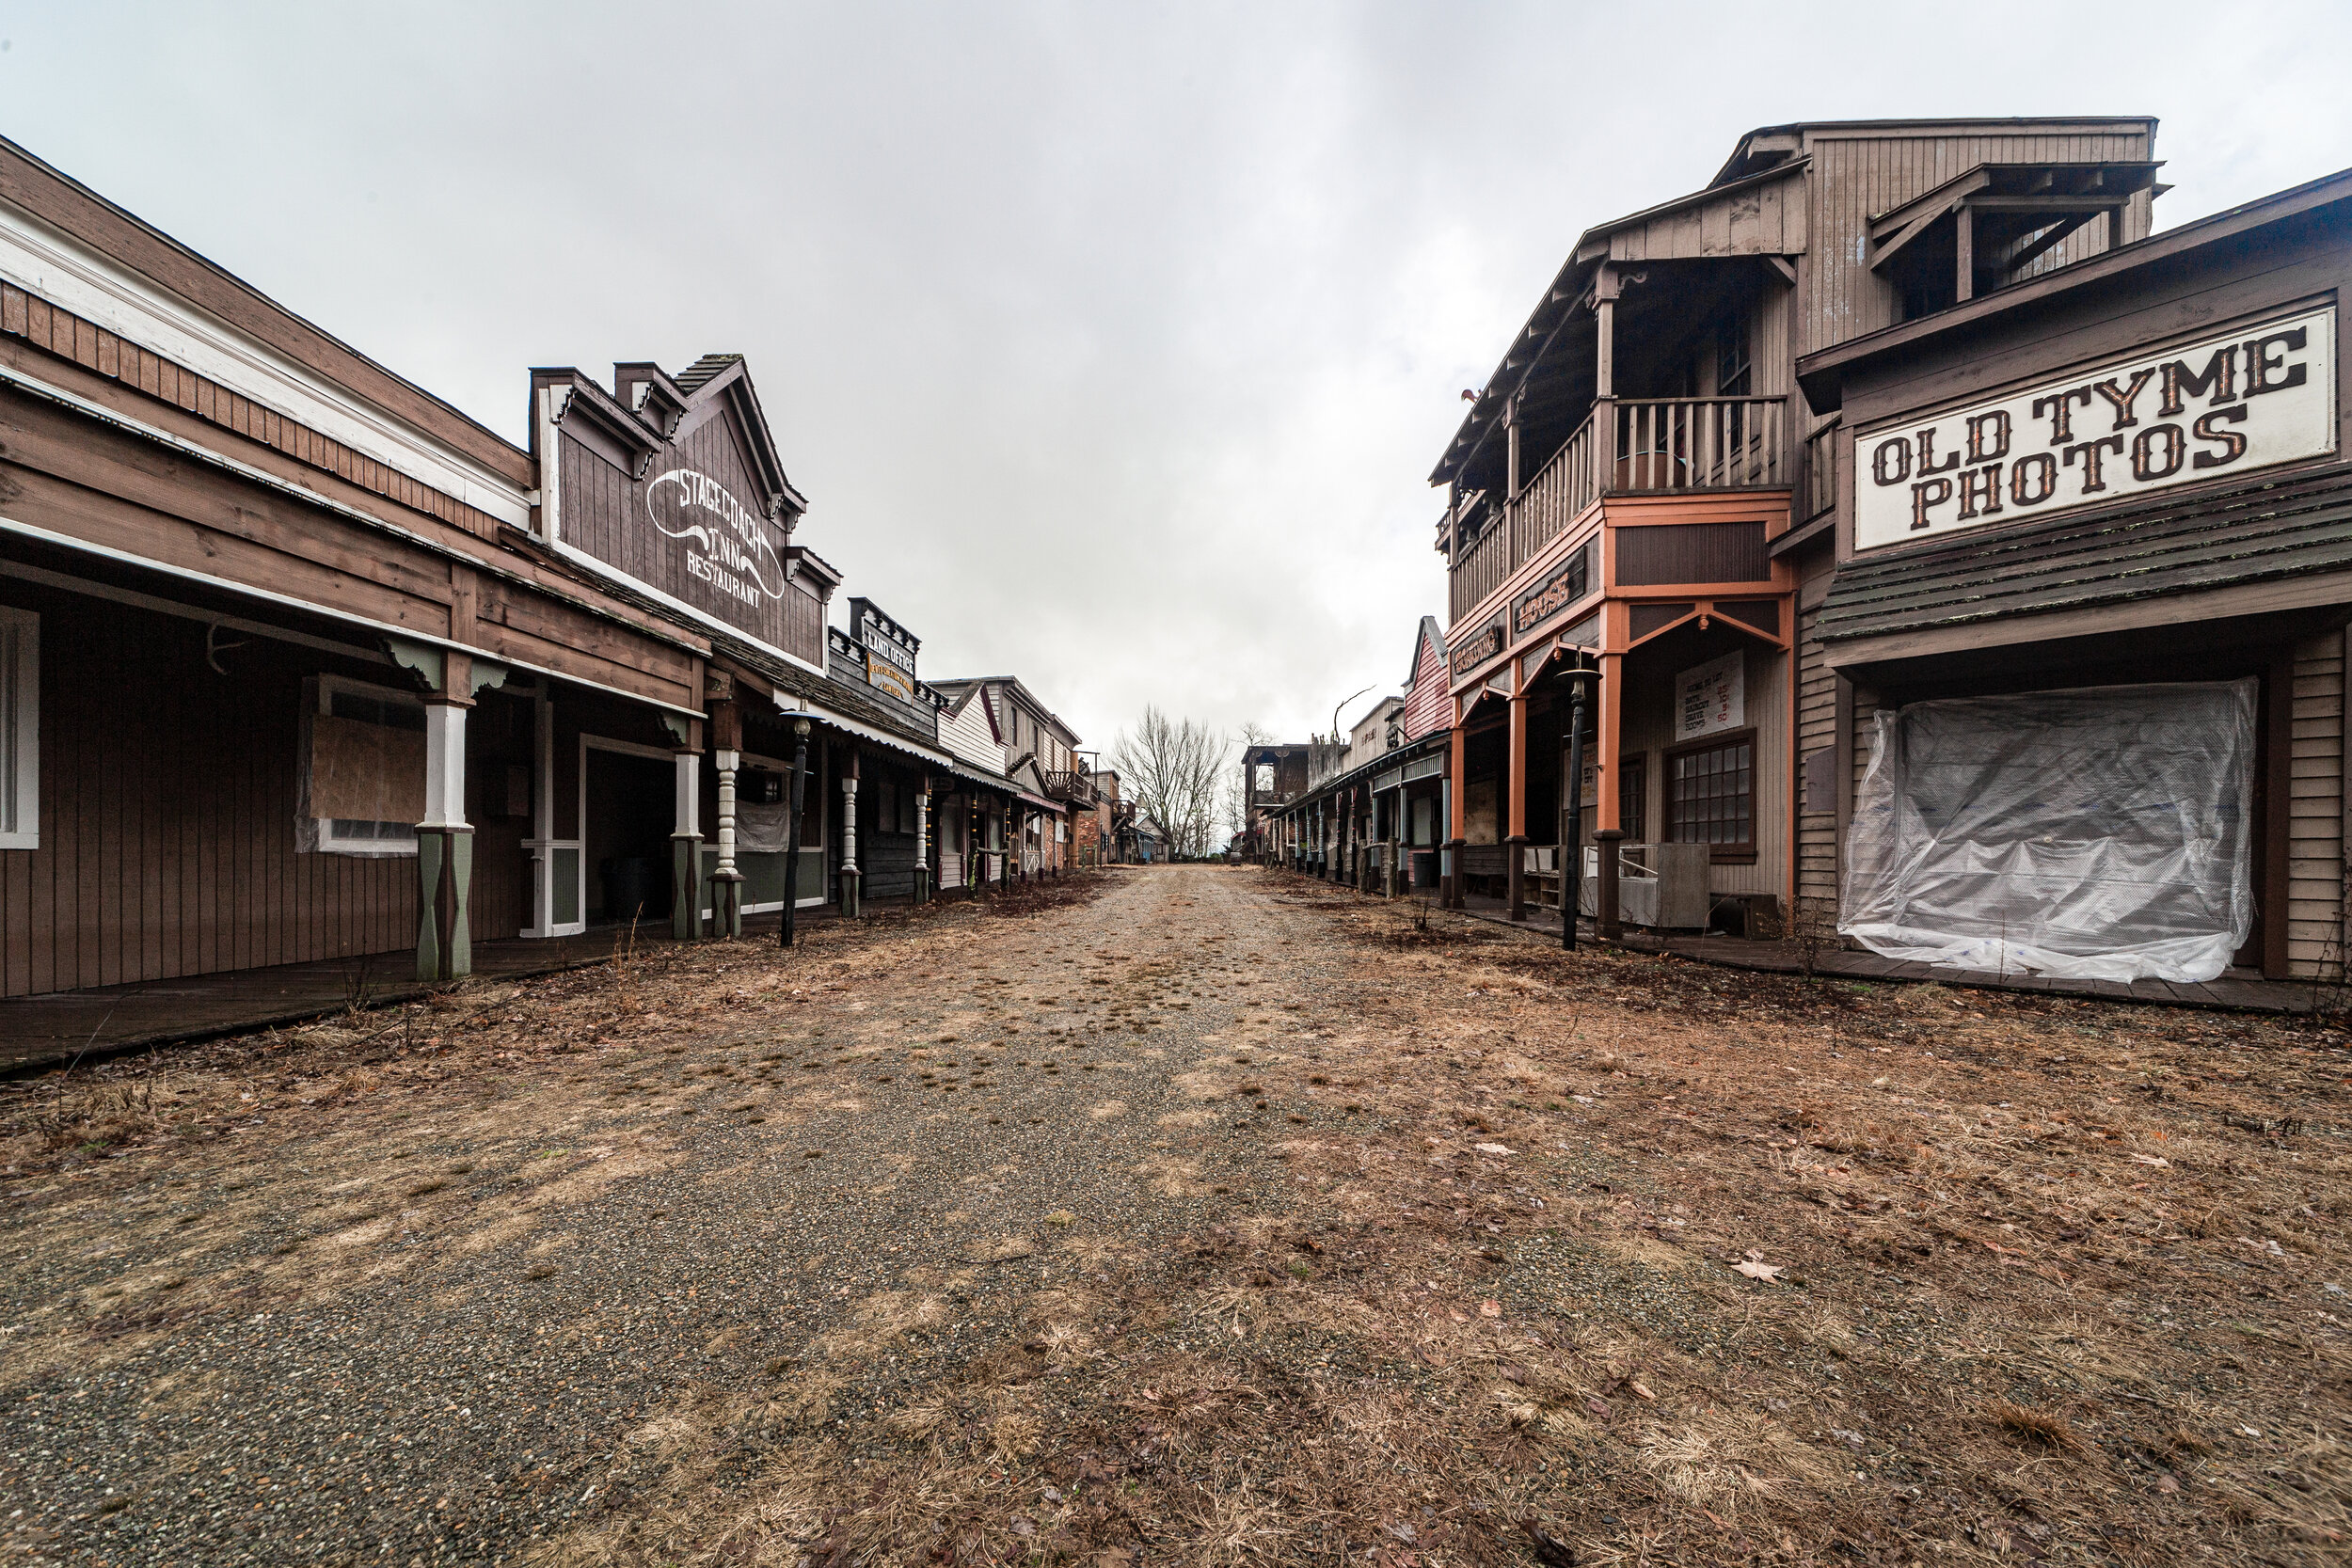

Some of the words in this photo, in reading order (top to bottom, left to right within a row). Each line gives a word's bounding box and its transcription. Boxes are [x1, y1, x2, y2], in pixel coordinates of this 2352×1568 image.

[1871, 409, 2013, 487] OLD
[2032, 325, 2308, 447] TYME
[1910, 403, 2249, 531] PHOTOS
[678, 468, 763, 561] STAGECOACH
[707, 528, 741, 572] INN
[686, 549, 760, 609] RESTAURANT
[1454, 628, 1496, 673] BOARDING
[1518, 572, 1569, 629] HOUSE
[867, 631, 889, 658] LAND
[890, 647, 914, 675] OFFICE
[1685, 700, 1709, 713] HAIRCUT
[1685, 710, 1704, 722] SHAVE
[1685, 719, 1706, 731] ROOMS
